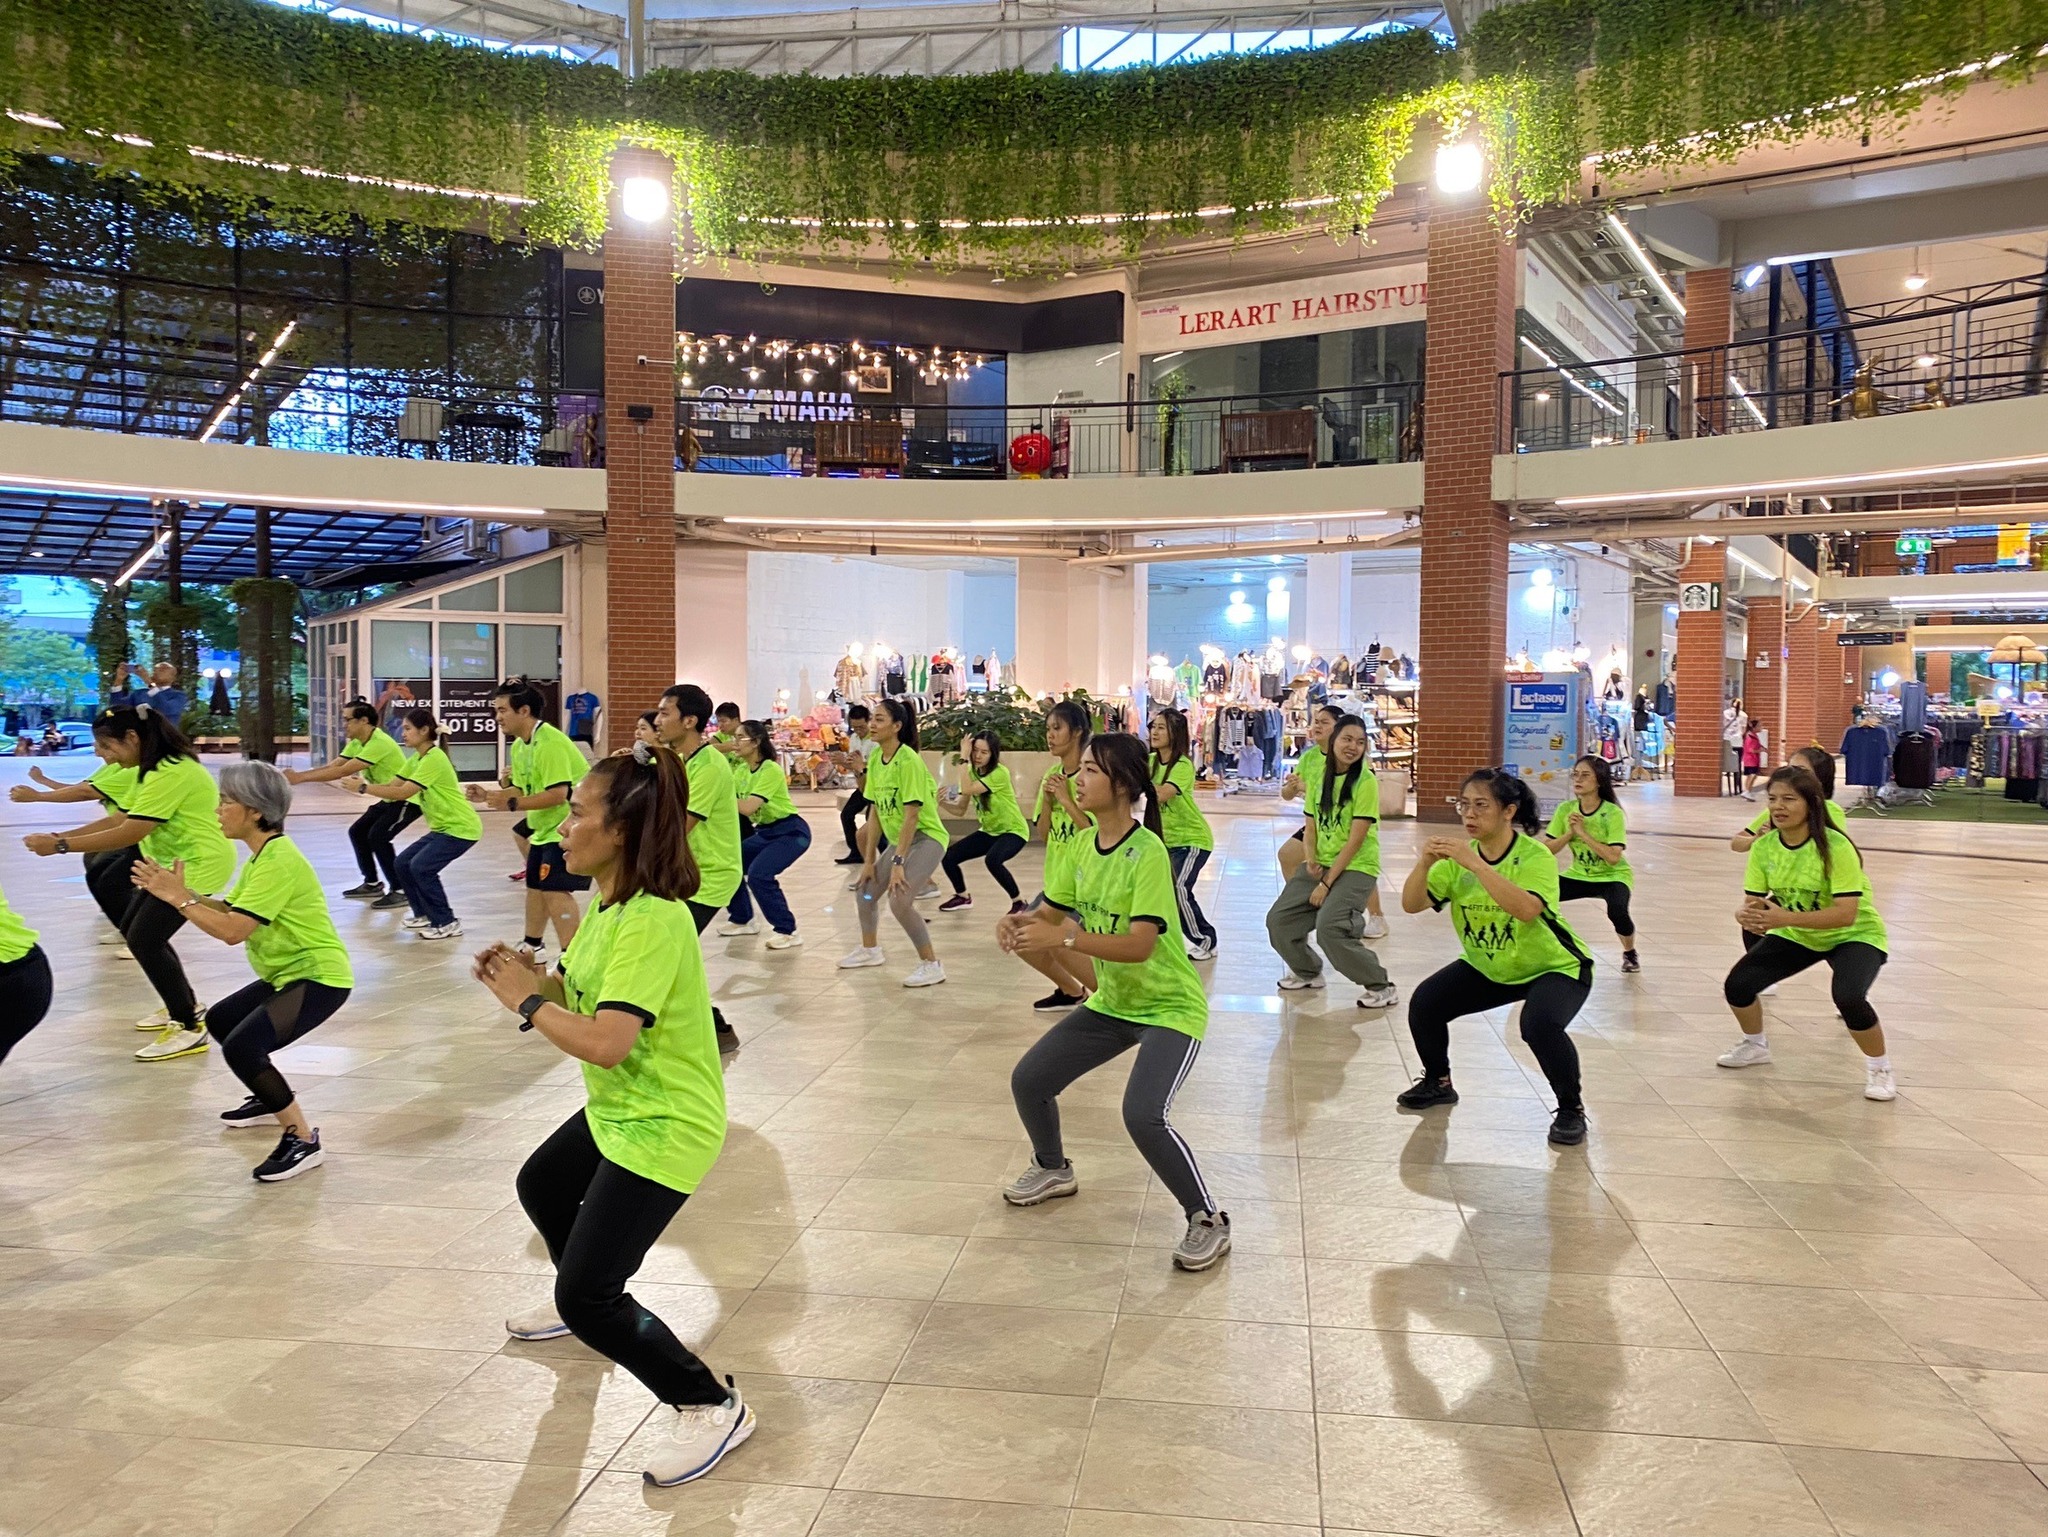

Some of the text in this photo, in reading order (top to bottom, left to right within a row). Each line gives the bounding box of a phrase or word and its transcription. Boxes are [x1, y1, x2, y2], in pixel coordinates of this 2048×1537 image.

[1179, 302, 1282, 335] LERART
[737, 387, 855, 422] YAMAHA
[391, 700, 415, 708] NEW
[1512, 687, 1565, 710] Lactasoy
[473, 719, 497, 733] 58
[1508, 724, 1550, 738] Original
